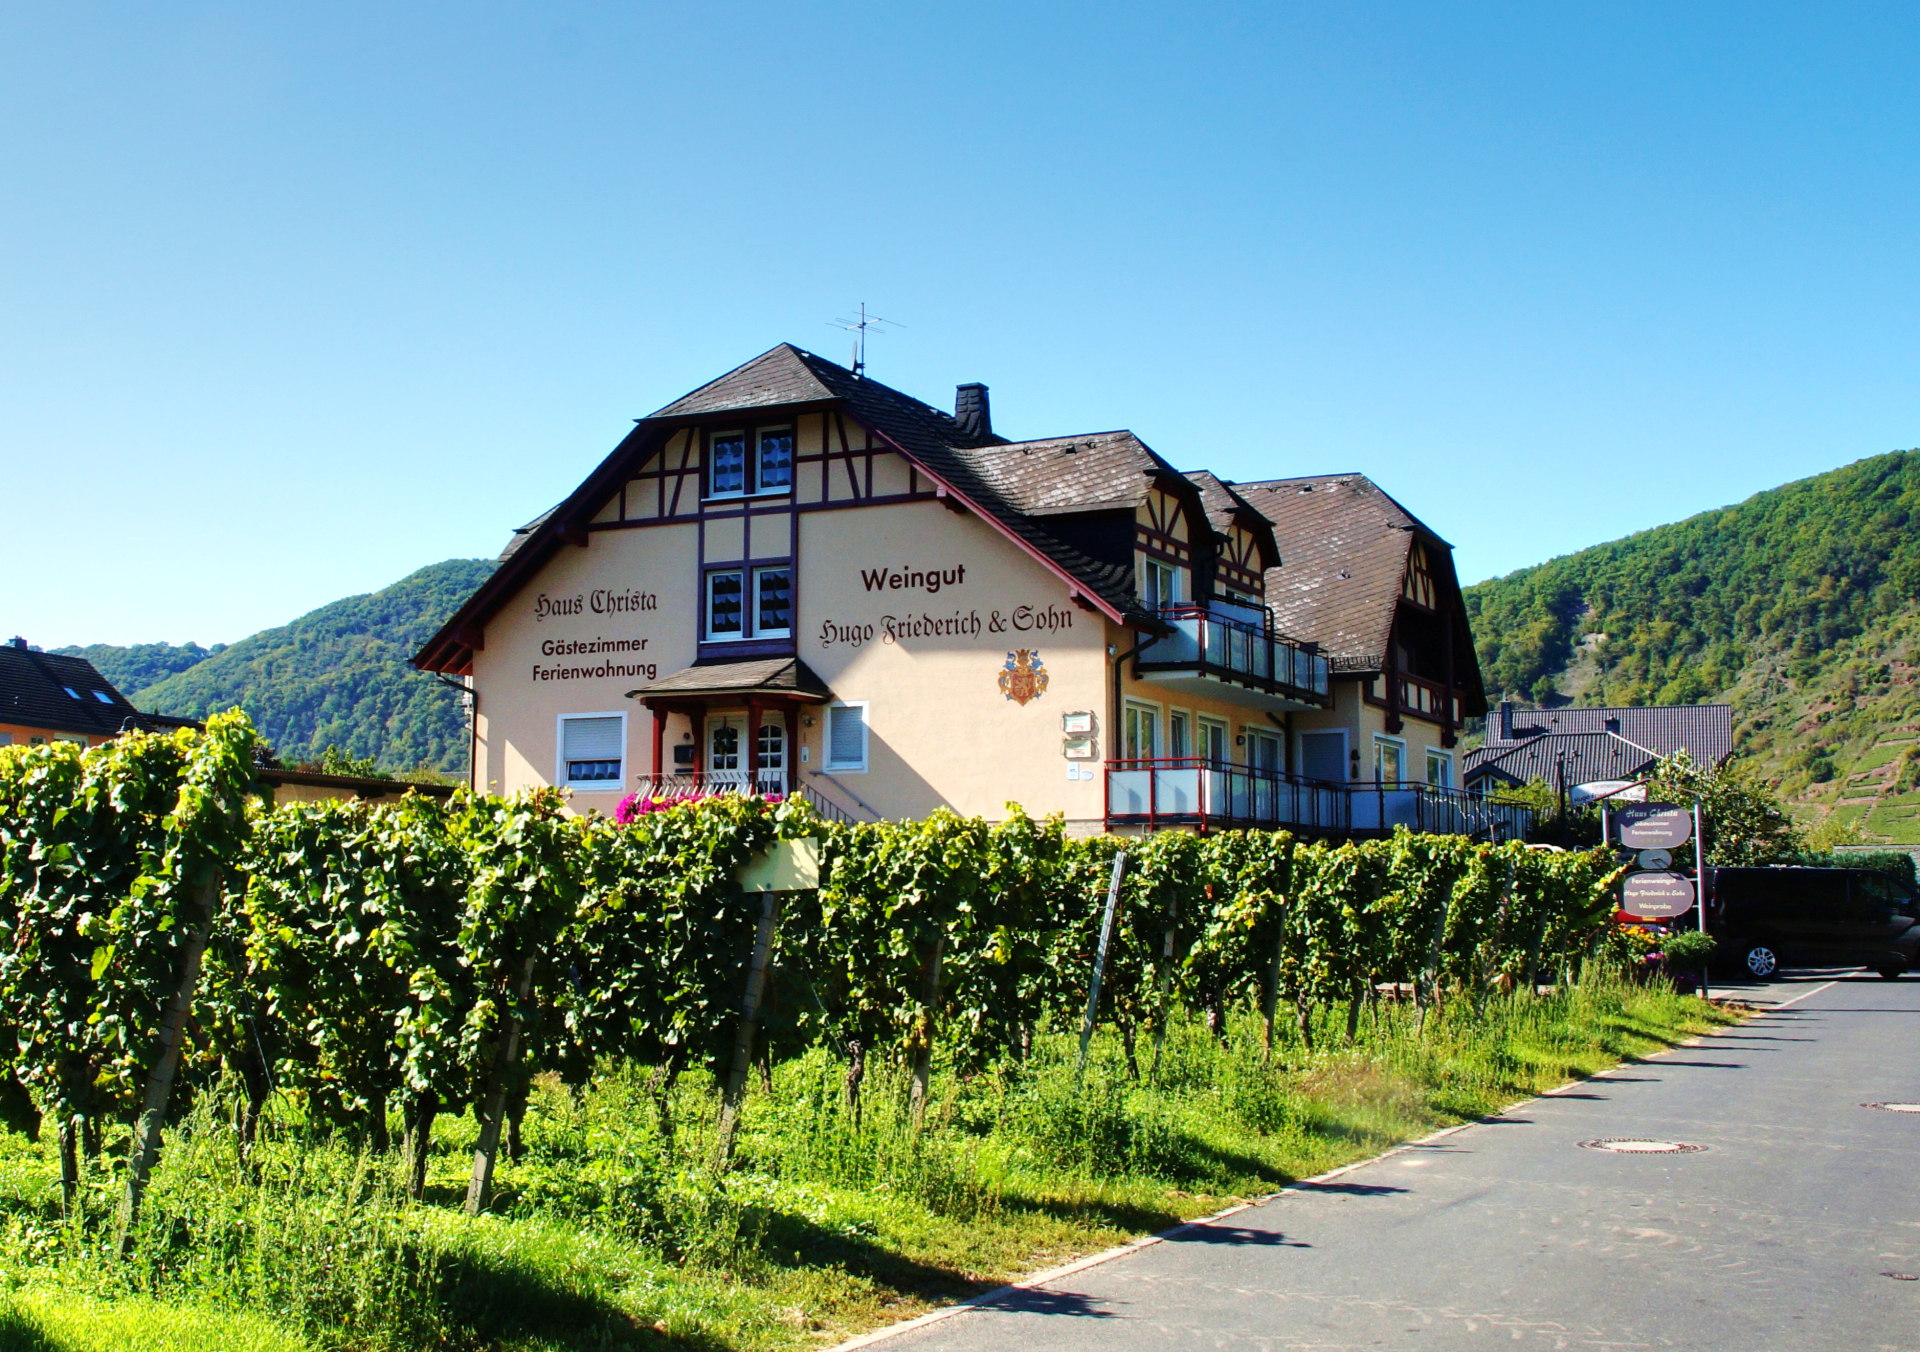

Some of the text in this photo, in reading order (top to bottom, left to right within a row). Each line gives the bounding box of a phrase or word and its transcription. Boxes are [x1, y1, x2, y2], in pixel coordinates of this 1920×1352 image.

[861, 564, 966, 593] Weingut
[534, 588, 657, 622] Haus Christa
[819, 604, 1073, 649] Hugo Friederich & Sohn
[541, 637, 648, 656] Gästezimmer
[533, 659, 657, 681] Ferienwohnung
[1626, 808, 1678, 818] Haus Christa
[1631, 829, 1673, 837] Ferienwohnung
[1631, 877, 1677, 885] Ferienweingut
